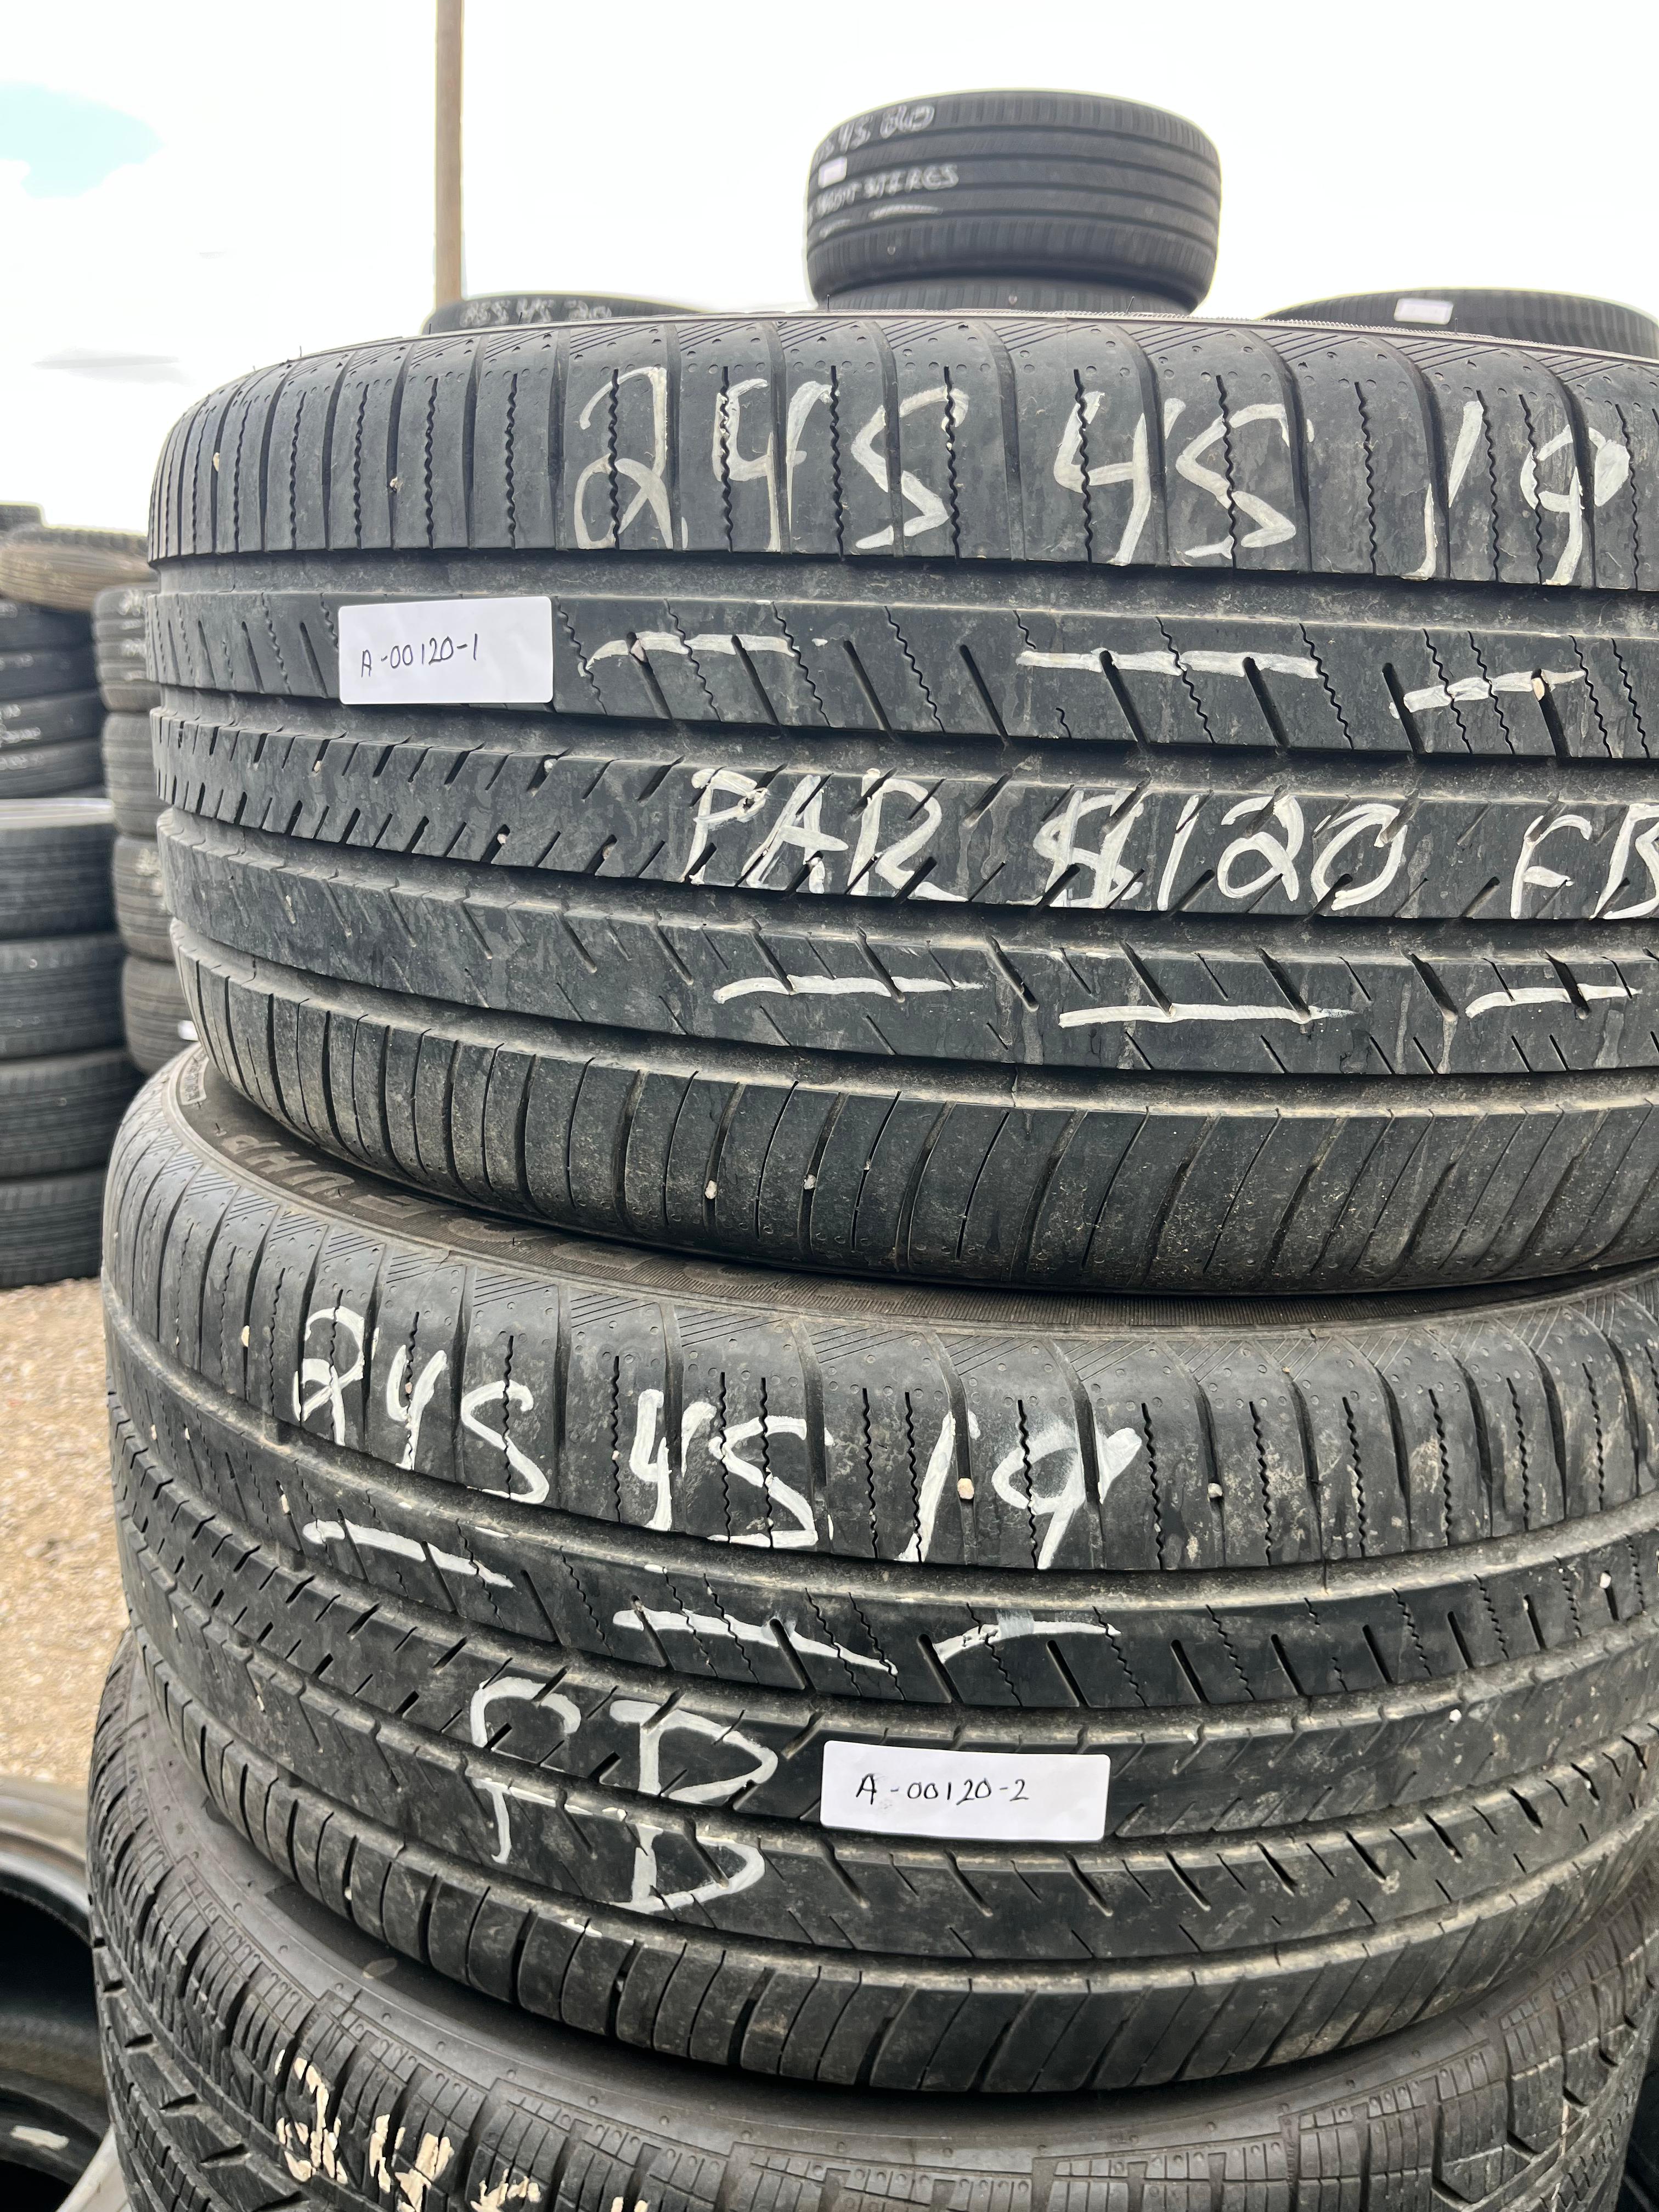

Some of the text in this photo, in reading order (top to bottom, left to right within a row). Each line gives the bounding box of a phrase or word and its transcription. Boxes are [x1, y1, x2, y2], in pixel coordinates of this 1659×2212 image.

[564, 366, 970, 551] 245
[1054, 391, 1315, 566] 45
[360, 633, 478, 678] A-00120-1
[680, 768, 968, 902] PAR
[221, 1134, 356, 1194] UHP
[292, 1305, 550, 1504] 245
[629, 1389, 834, 1548] 45
[856, 1773, 1029, 1805] A-00120-2
